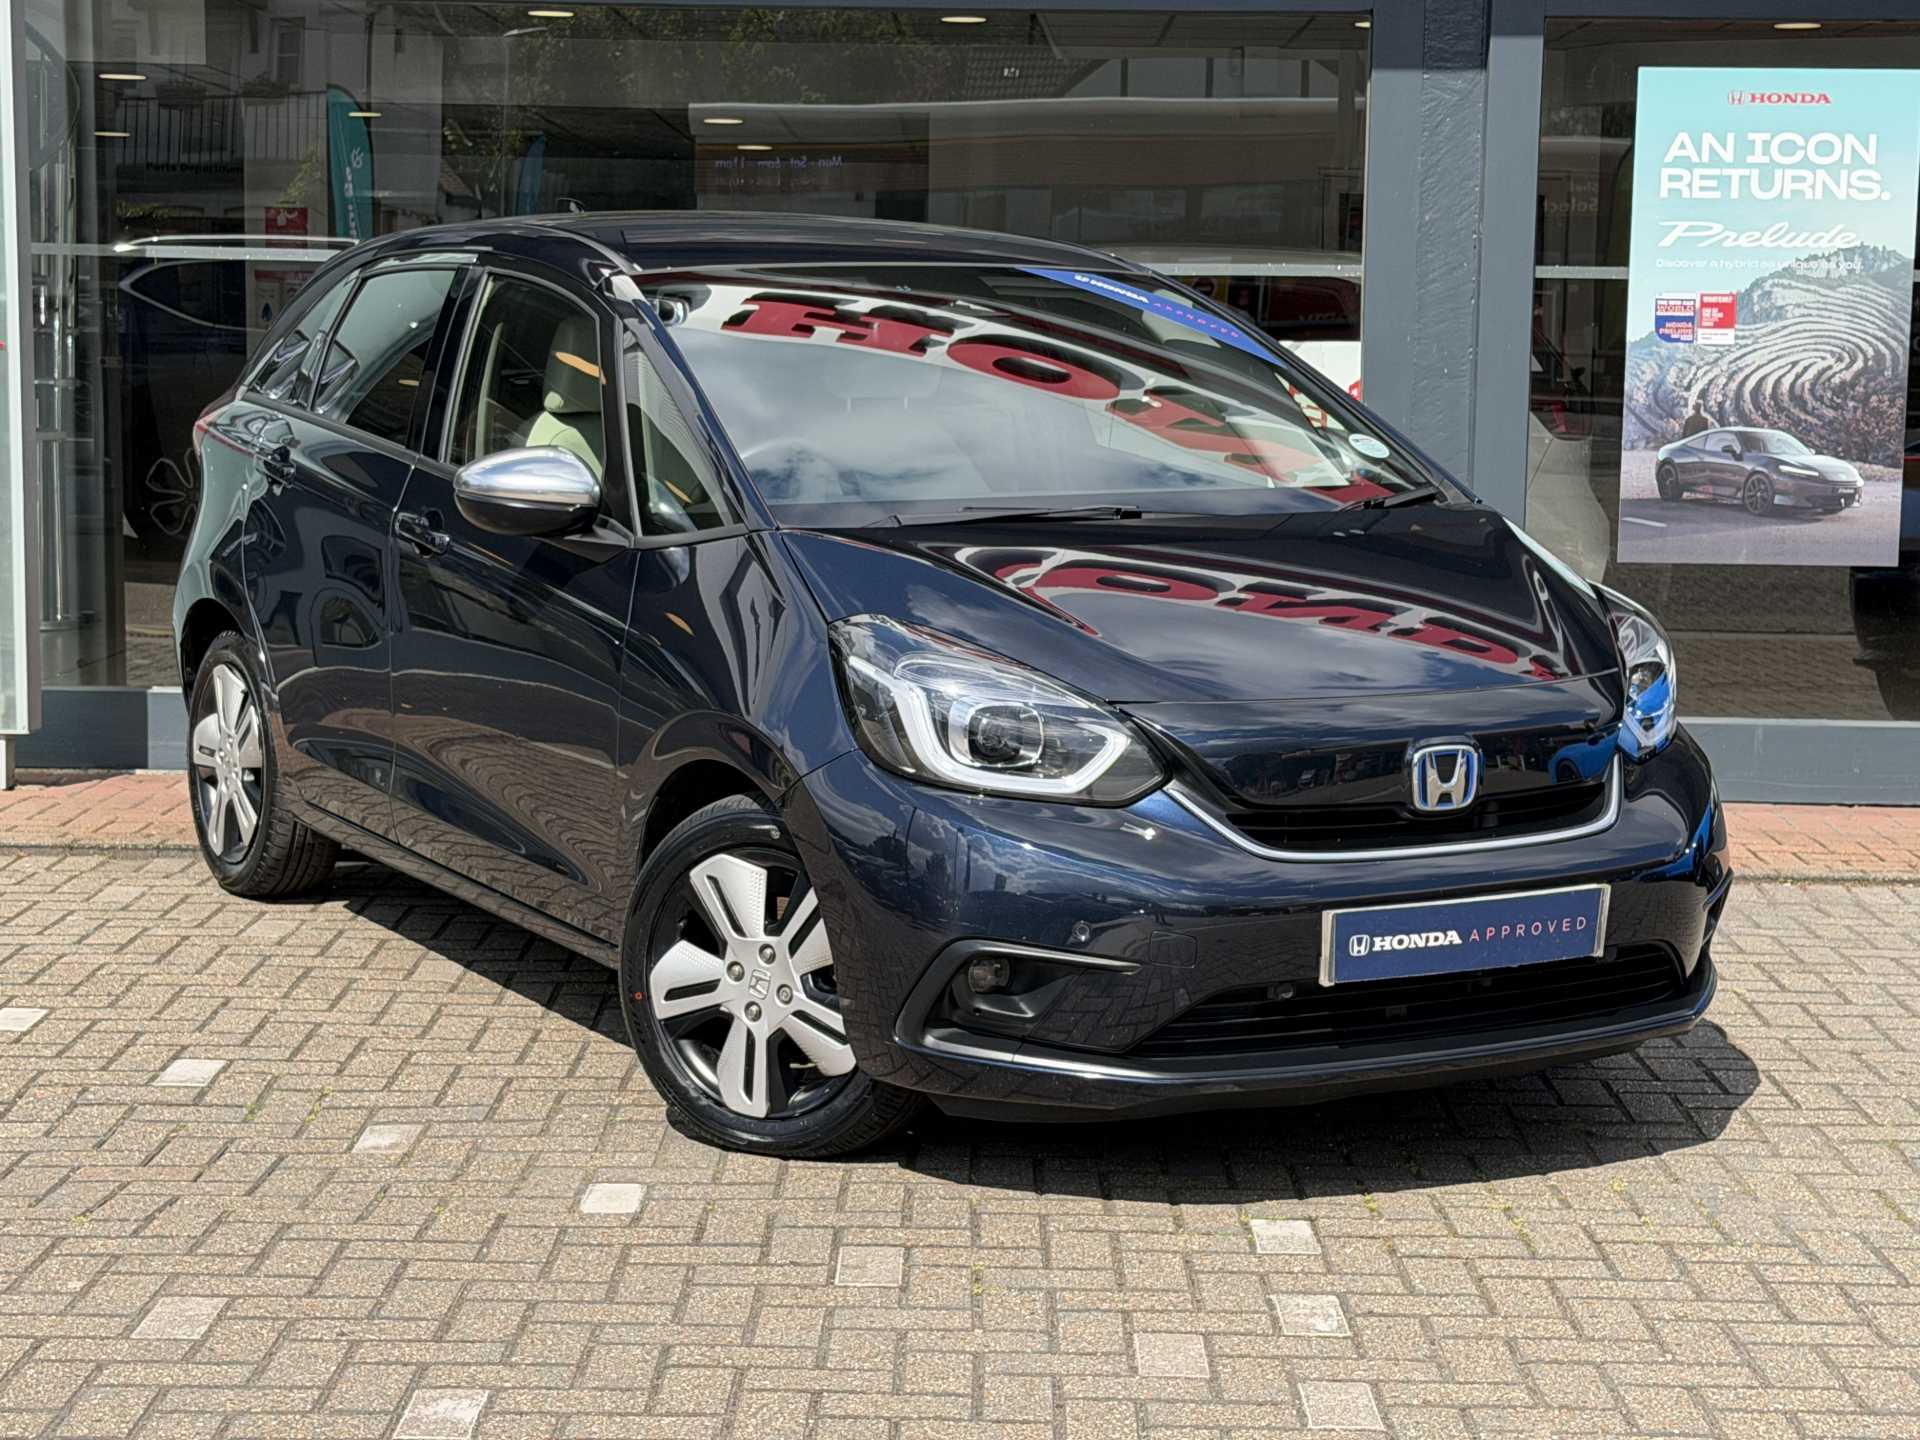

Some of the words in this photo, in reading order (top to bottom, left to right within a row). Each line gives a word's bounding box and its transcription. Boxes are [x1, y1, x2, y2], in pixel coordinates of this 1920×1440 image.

[1750, 92, 1831, 105] HONDA
[1663, 131, 1734, 164] AN
[1745, 132, 1878, 166] ICON
[1659, 168, 1891, 201] RETURNS.
[1658, 221, 1858, 248] Prelude
[1372, 930, 1463, 952] HONDA
[1469, 915, 1587, 943] APPROVED
